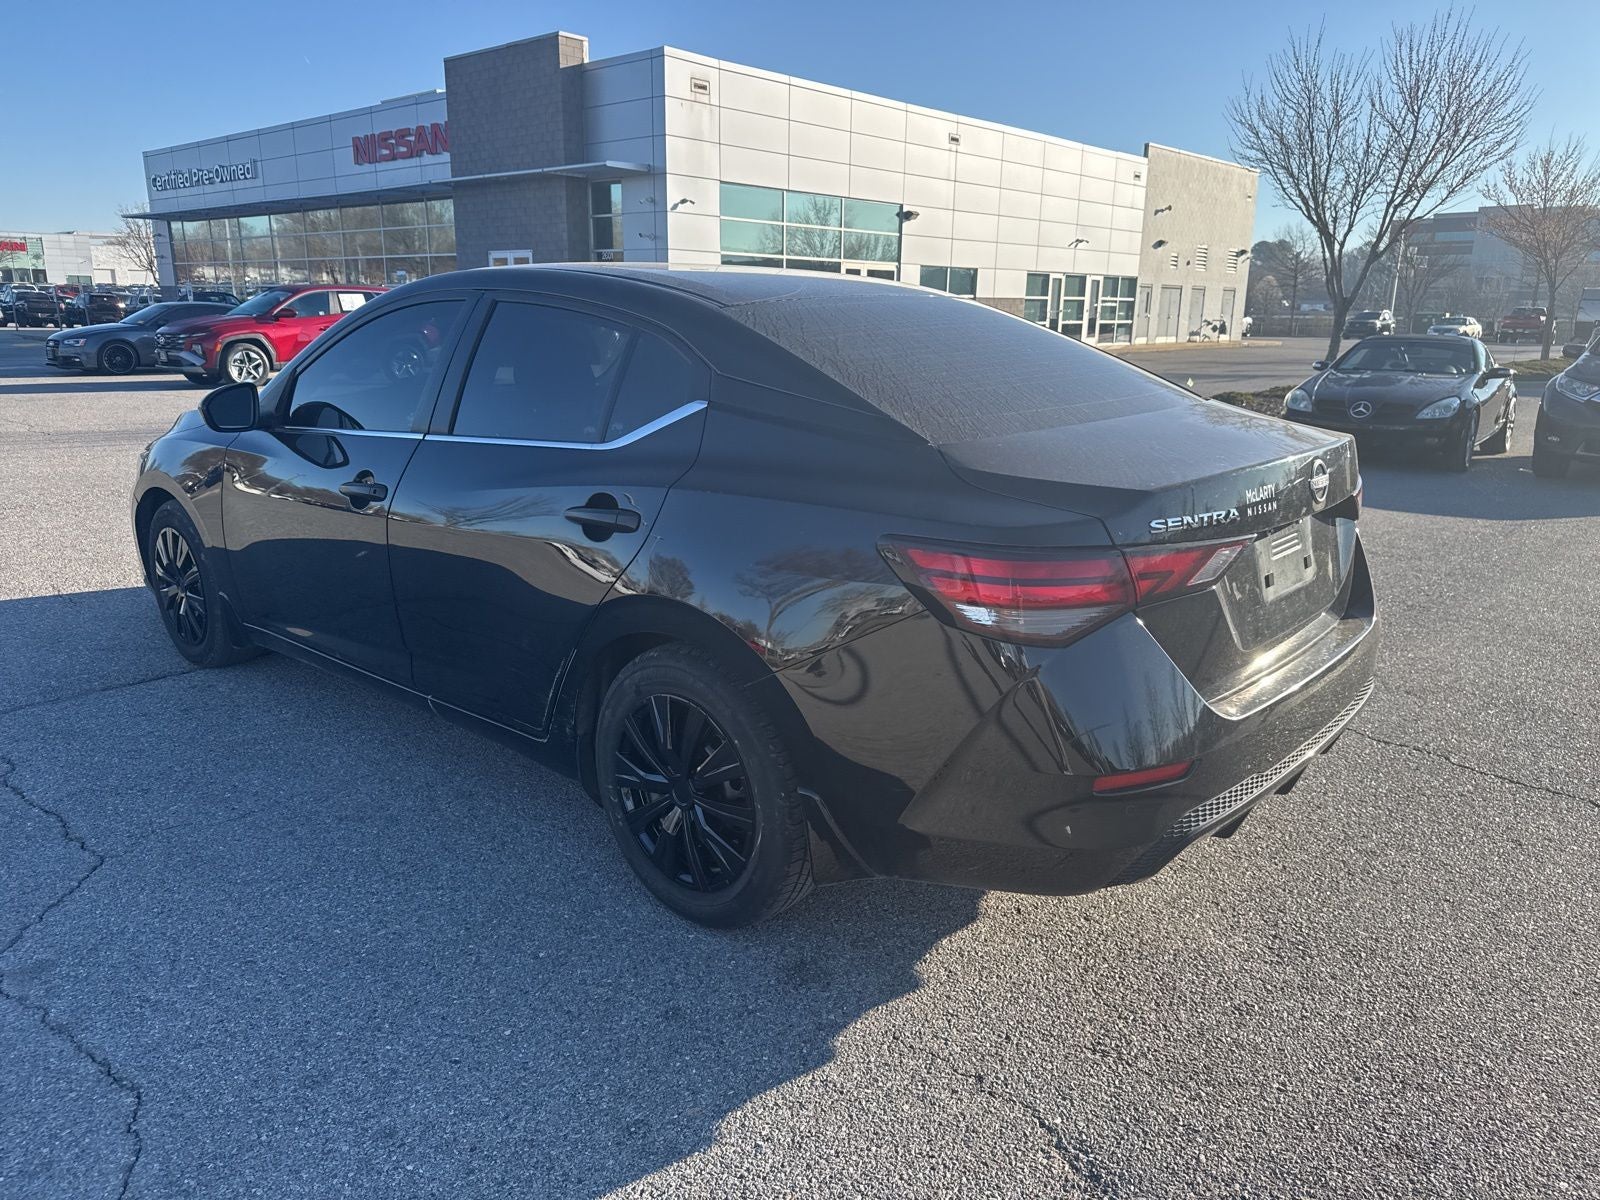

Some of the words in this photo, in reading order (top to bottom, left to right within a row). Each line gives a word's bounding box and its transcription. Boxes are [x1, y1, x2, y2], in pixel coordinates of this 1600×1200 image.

[352, 121, 449, 165] NISSAN
[151, 168, 191, 191] Certified
[192, 159, 254, 187] Pre-Owned
[1245, 483, 1276, 504] McLARTY
[1149, 508, 1240, 534] SENTRA
[1247, 501, 1278, 517] NISSAN
